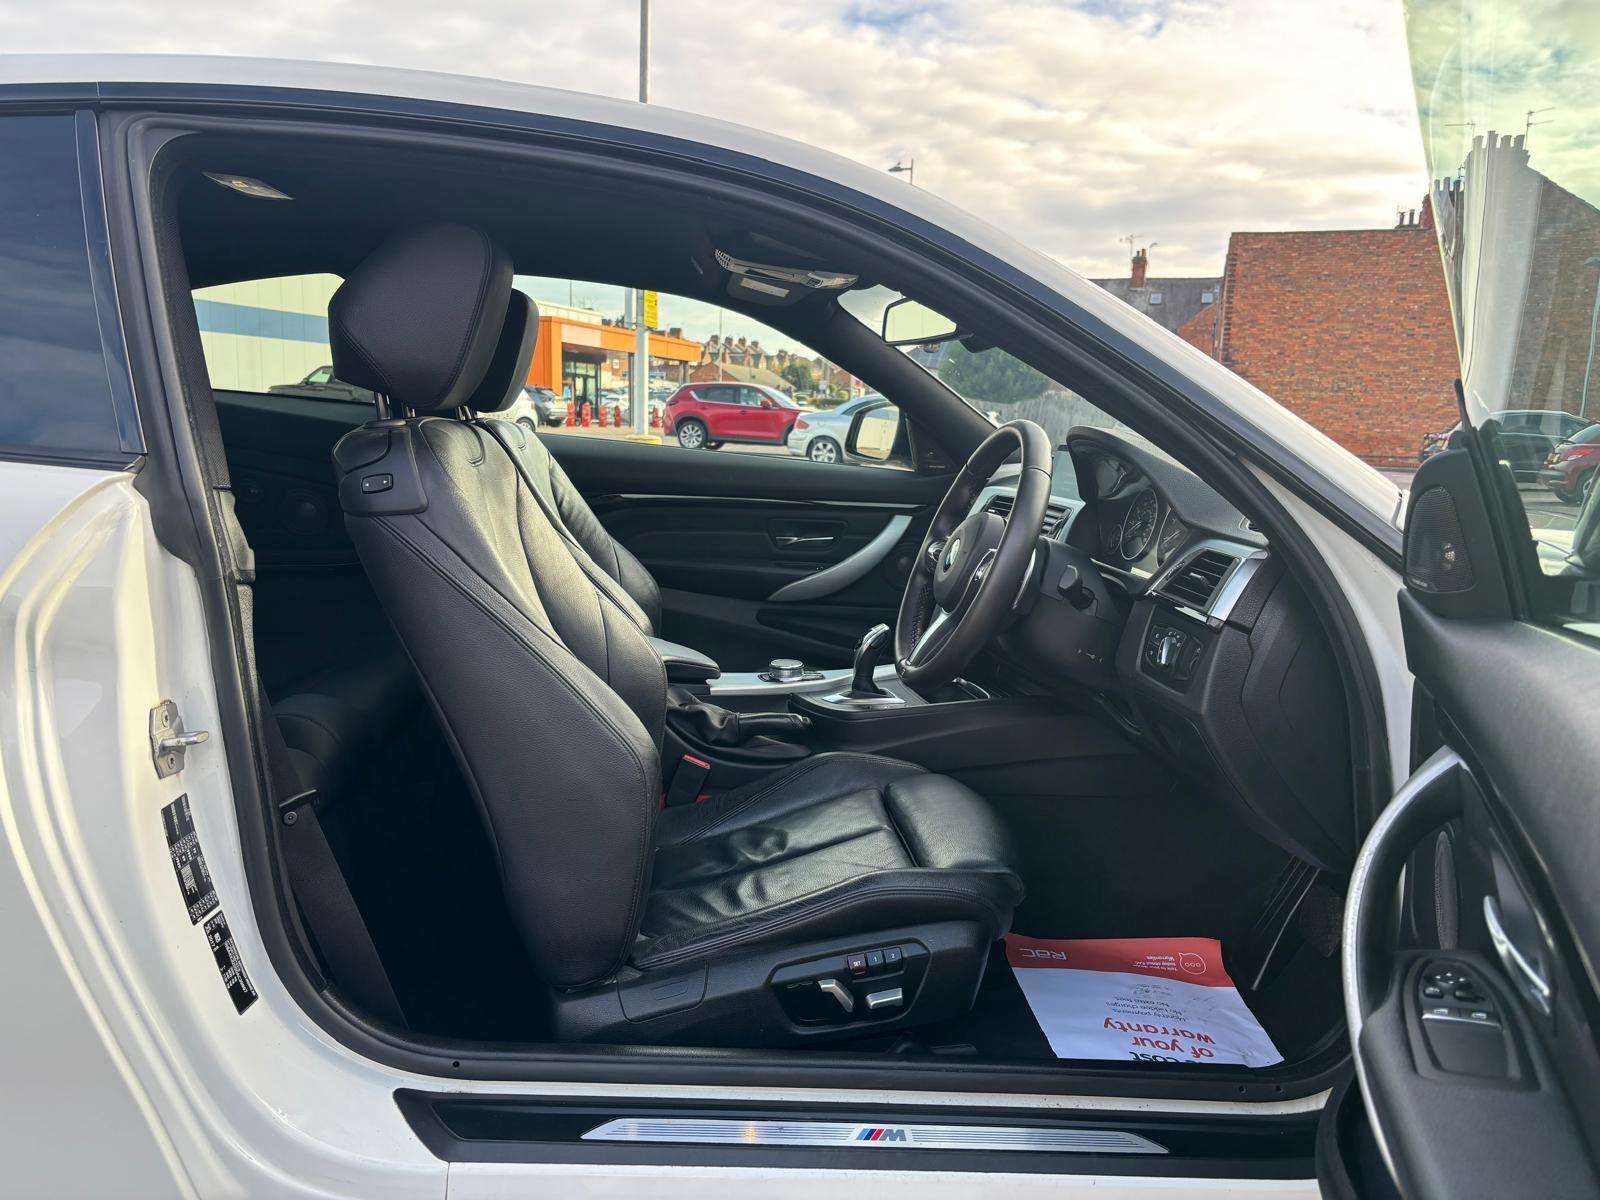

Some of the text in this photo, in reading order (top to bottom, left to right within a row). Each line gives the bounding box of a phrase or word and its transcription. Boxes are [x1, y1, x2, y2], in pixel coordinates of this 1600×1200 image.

[1103, 1017, 1216, 1045] warranty
[1132, 1036, 1215, 1059] of your
